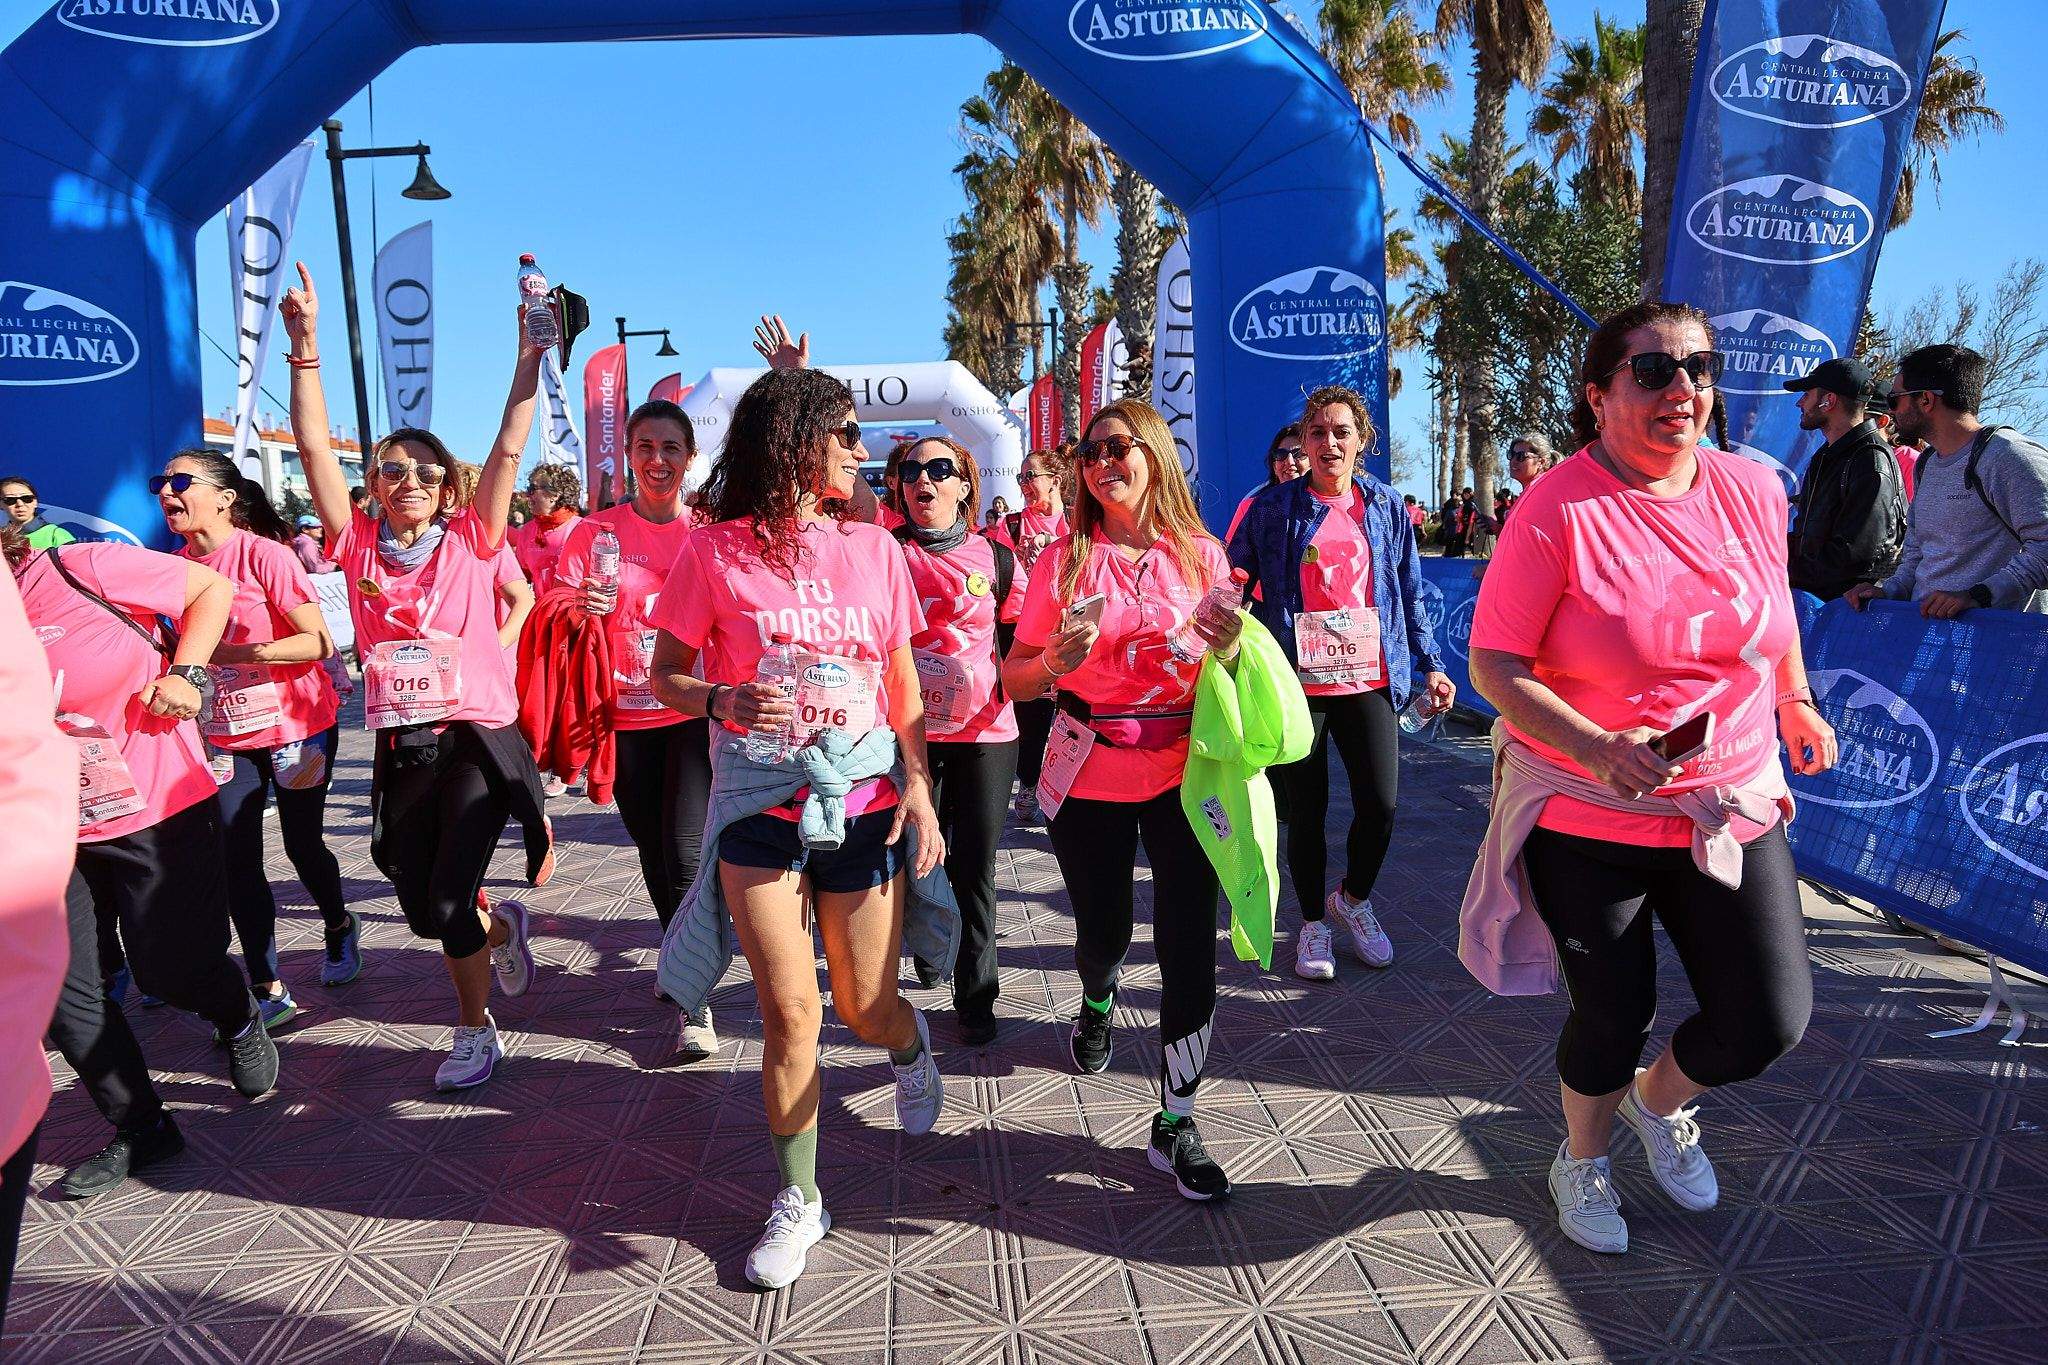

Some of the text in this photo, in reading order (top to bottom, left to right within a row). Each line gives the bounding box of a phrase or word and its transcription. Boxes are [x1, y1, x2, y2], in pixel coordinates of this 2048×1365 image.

[1086, 2, 1258, 42] ASTURIANA
[1761, 61, 1891, 81] CENTRAL LECHERA
[1722, 62, 1891, 107] ASTURIANA
[1733, 201, 1857, 219] CENTRAL LECHERA
[1699, 202, 1856, 246] ASTURIANA
[1269, 299, 1331, 311] CENTRAL
[31, 318, 114, 335] LECHERA
[1241, 305, 1382, 341] ASTURIANA
[385, 278, 431, 429] SHO
[1719, 336, 1823, 353] ENTRAL LECHERA
[599, 369, 615, 454] Santander
[951, 406, 997, 417] OYSHO
[796, 578, 834, 605] TU
[756, 606, 874, 648] DORSAL
[1326, 642, 1357, 657] 016
[393, 677, 430, 692] 016
[805, 669, 847, 684] ASTURIANA
[399, 694, 416, 702] 3282
[801, 704, 847, 727] 016
[1719, 739, 1733, 759] LA
[1735, 728, 1764, 754] MUJER
[1697, 762, 1722, 776] 2025
[93, 803, 130, 817] Santander
